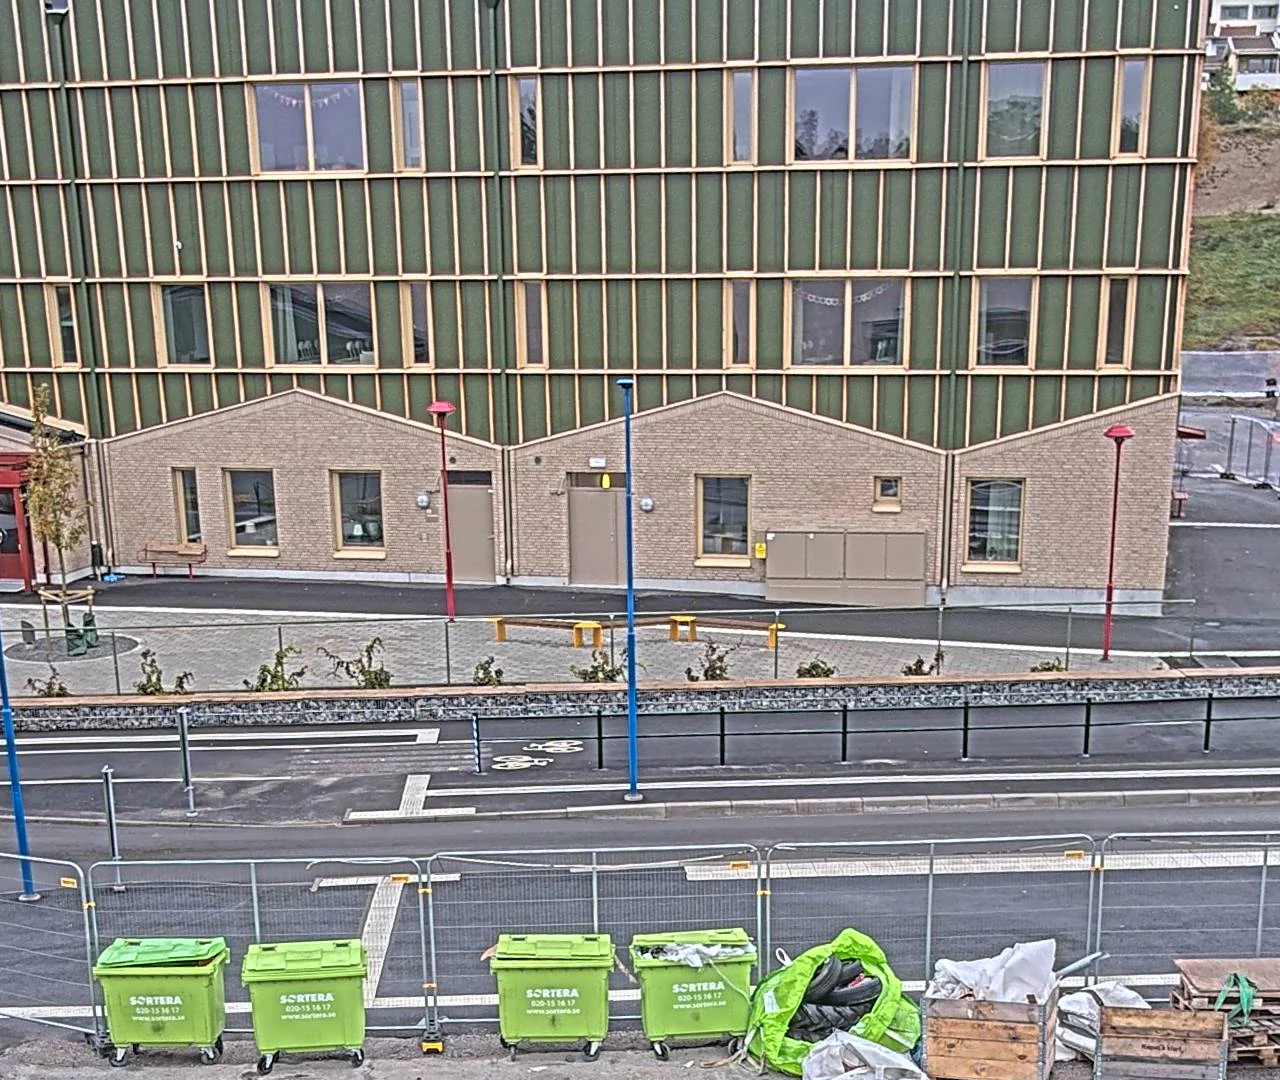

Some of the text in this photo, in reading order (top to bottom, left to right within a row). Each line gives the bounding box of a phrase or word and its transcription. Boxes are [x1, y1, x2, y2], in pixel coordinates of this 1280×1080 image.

[672, 981, 726, 993] SORTERA
[280, 992, 334, 1004] SORTERA
[526, 988, 579, 998] SORTERA
[129, 996, 182, 1005] SORTERA
